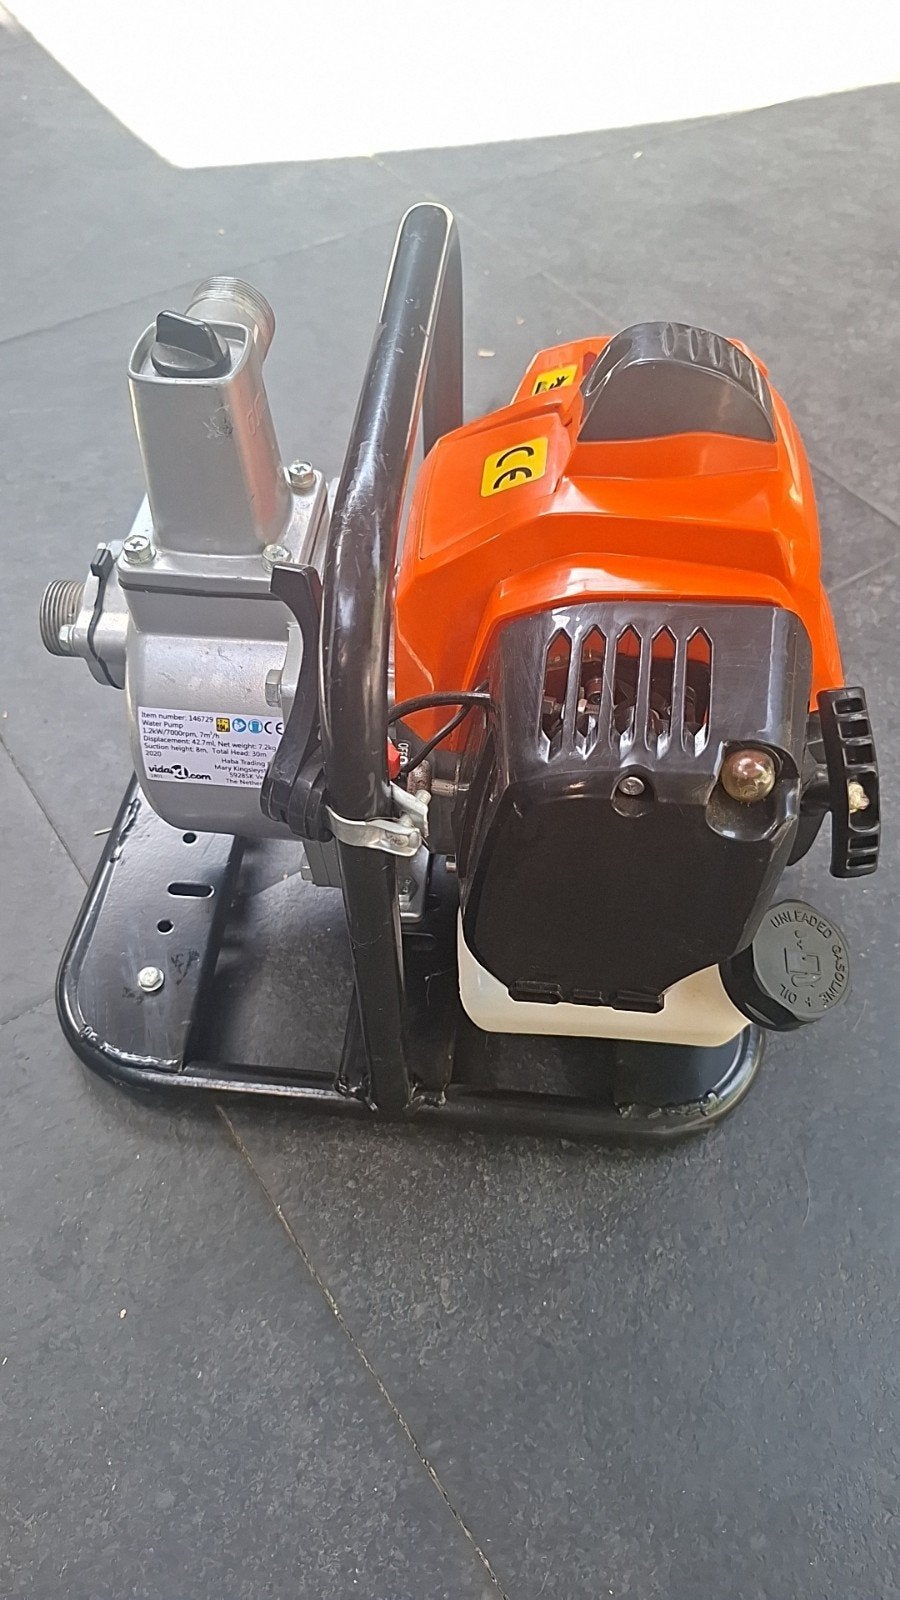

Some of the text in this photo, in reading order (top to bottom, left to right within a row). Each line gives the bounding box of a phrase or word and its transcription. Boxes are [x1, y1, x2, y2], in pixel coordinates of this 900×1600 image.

[141, 711, 214, 723] Item number: 146729
[142, 719, 184, 729] Water Pump
[143, 735, 190, 744] Displacement:
[258, 744, 277, 752] 7.2kg
[144, 742, 170, 750] Suction
[171, 744, 194, 753] height:
[212, 747, 229, 755] Total
[240, 759, 266, 767] Trading
[769, 909, 832, 939] UNLEADED
[818, 945, 845, 1004] GASOLINE
[779, 983, 798, 1004] OIL
